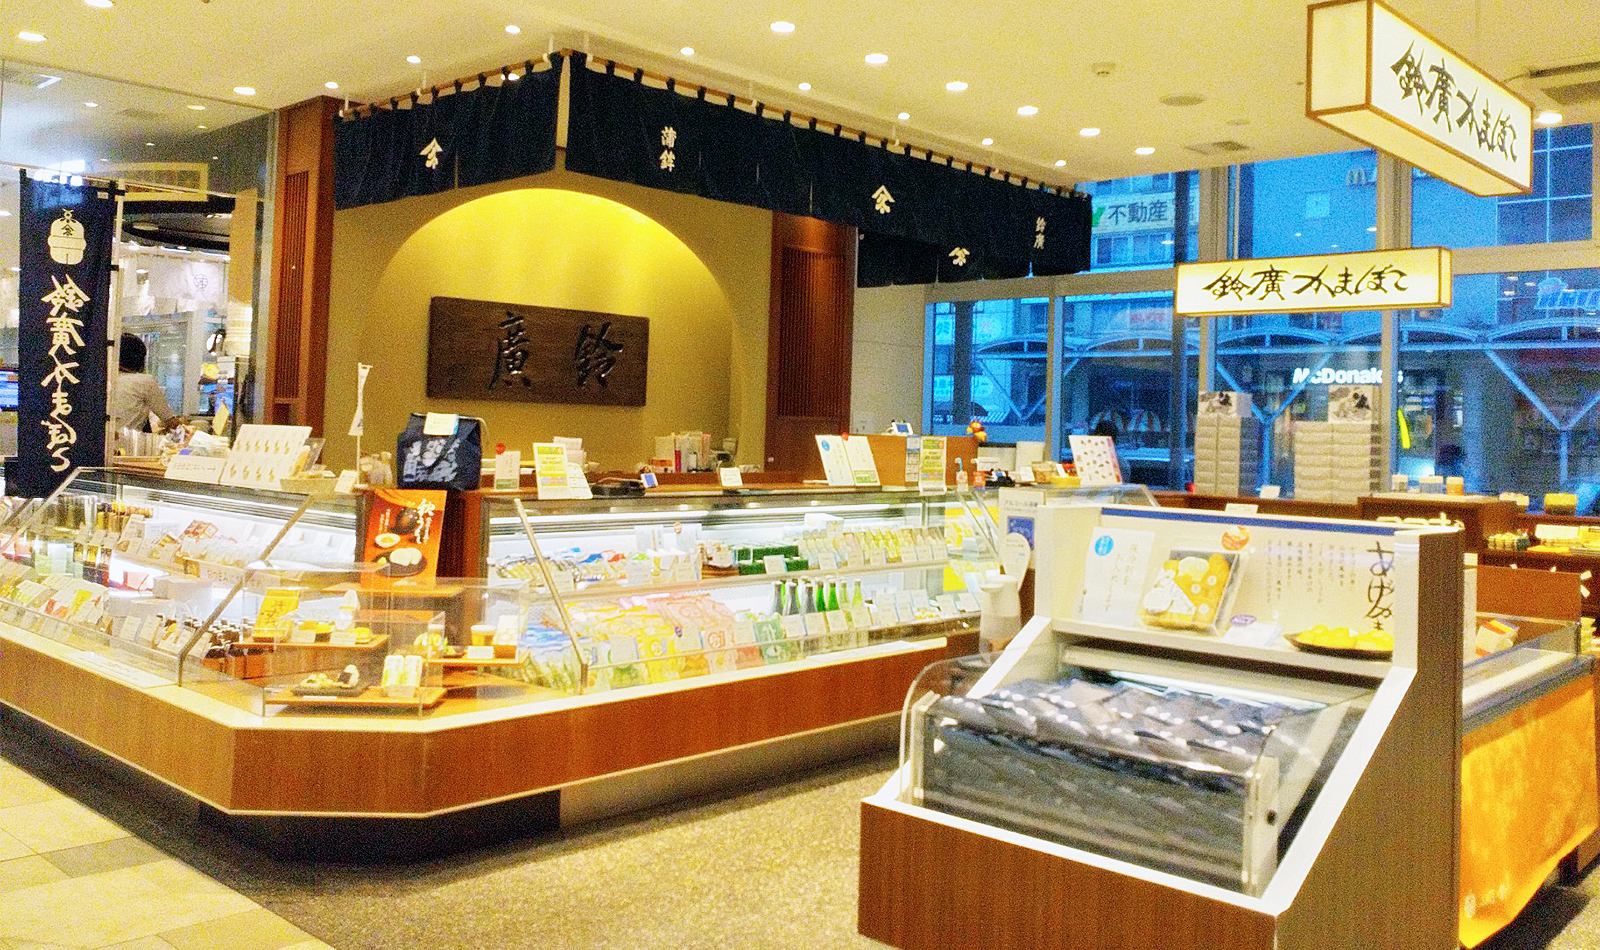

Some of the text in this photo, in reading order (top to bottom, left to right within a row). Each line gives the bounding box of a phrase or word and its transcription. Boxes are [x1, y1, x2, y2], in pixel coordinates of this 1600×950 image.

[660, 126, 677, 172] 蒲鉾
[1108, 200, 1168, 225] 不動産
